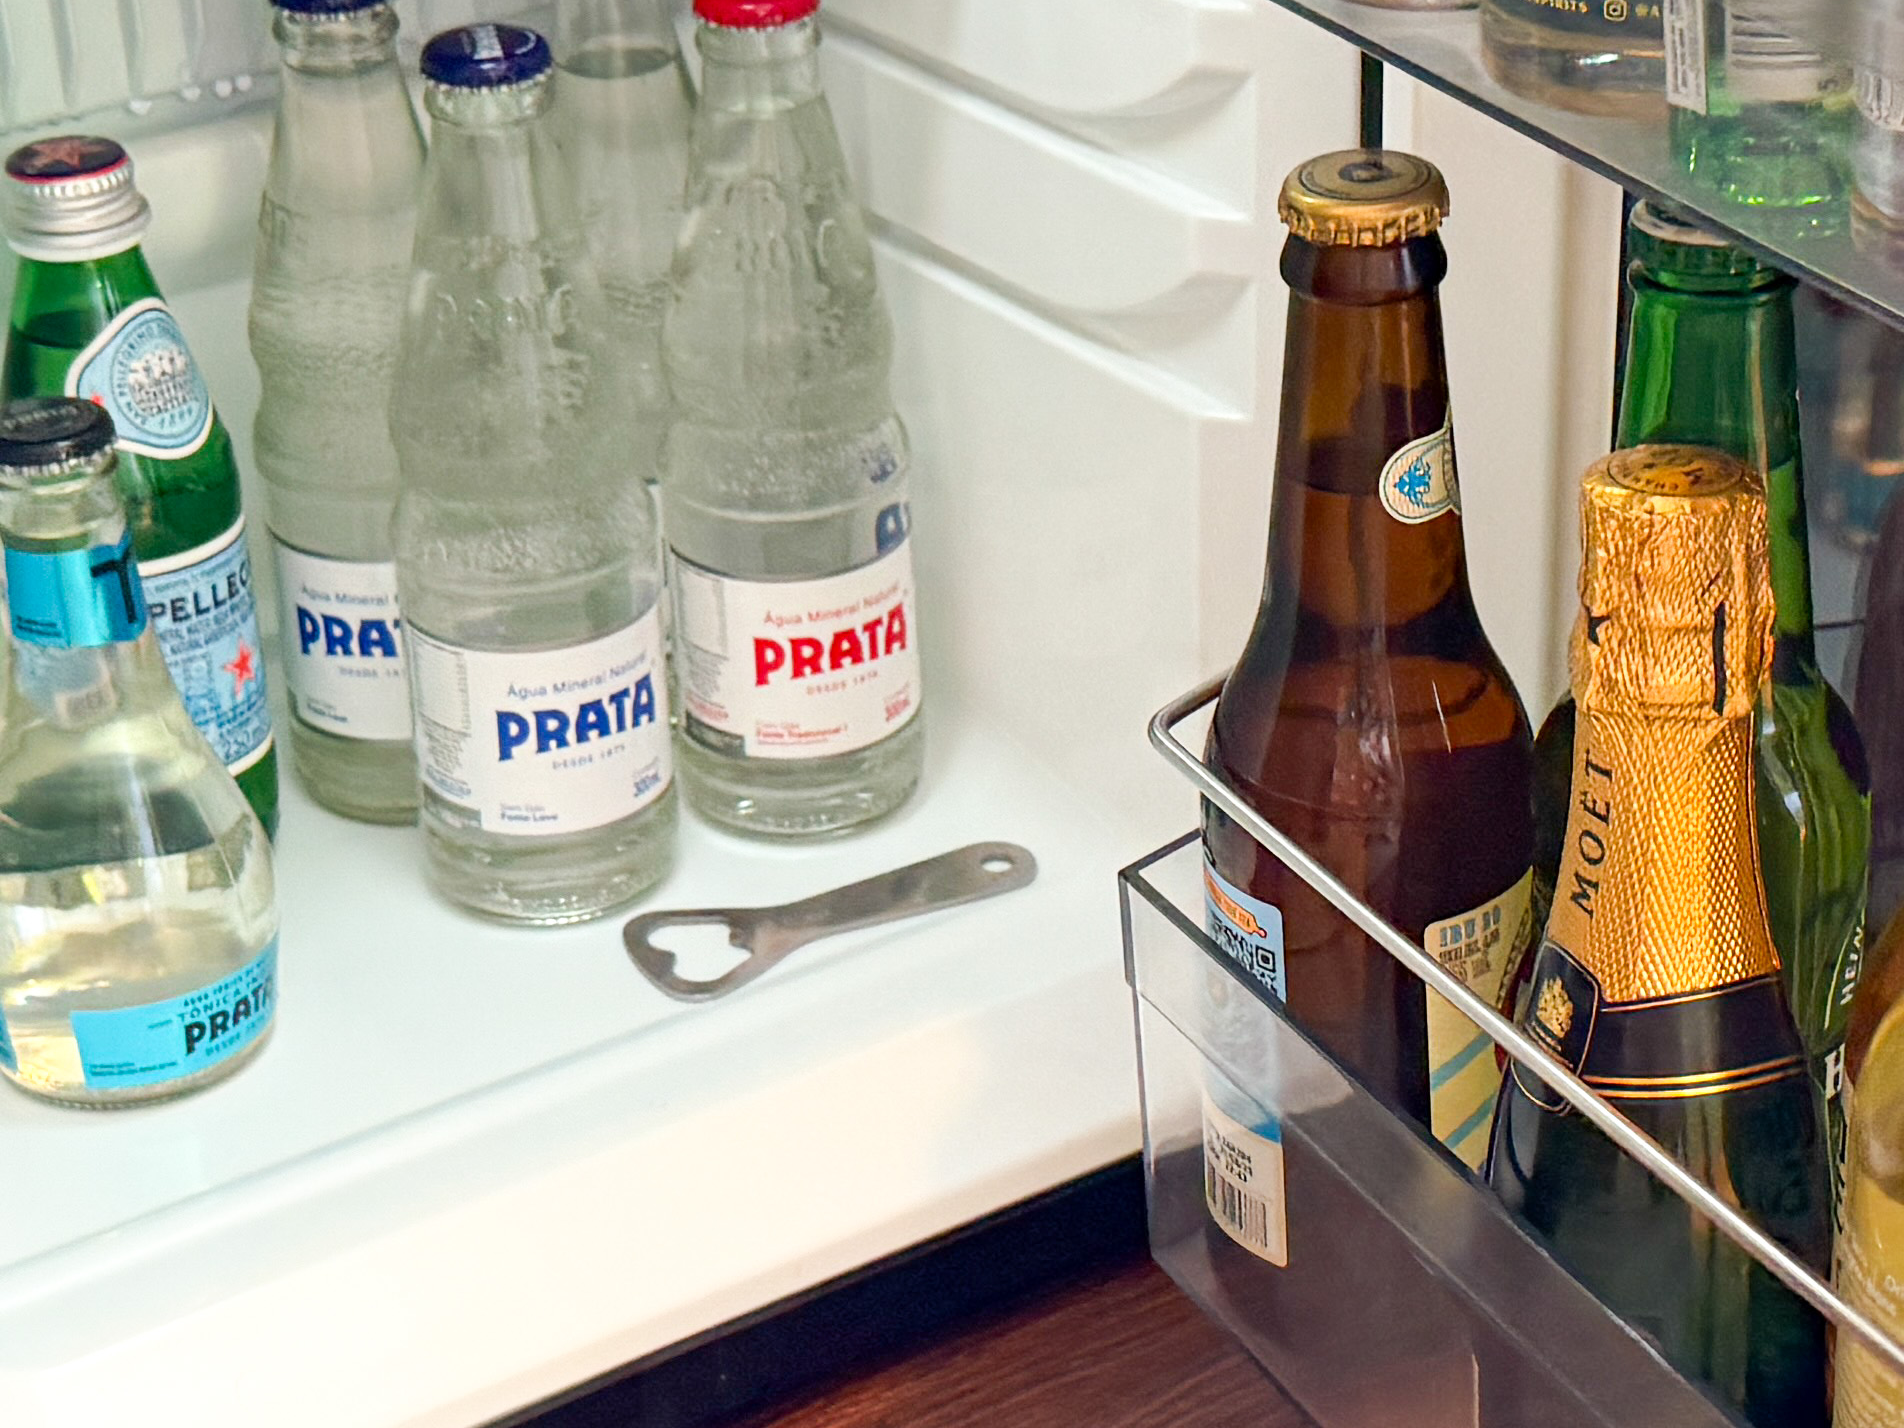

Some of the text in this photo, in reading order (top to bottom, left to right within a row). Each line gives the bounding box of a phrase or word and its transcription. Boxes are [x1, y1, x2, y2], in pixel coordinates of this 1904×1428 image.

[296, 605, 400, 658] PRA
[764, 580, 900, 628] Água Mineral Natural
[507, 648, 648, 701] Água Mineral Natural
[753, 602, 907, 688] PRATA
[495, 672, 656, 762] PRATA
[1569, 748, 1613, 919] MOËT
[1839, 925, 1864, 1006] HEIN
